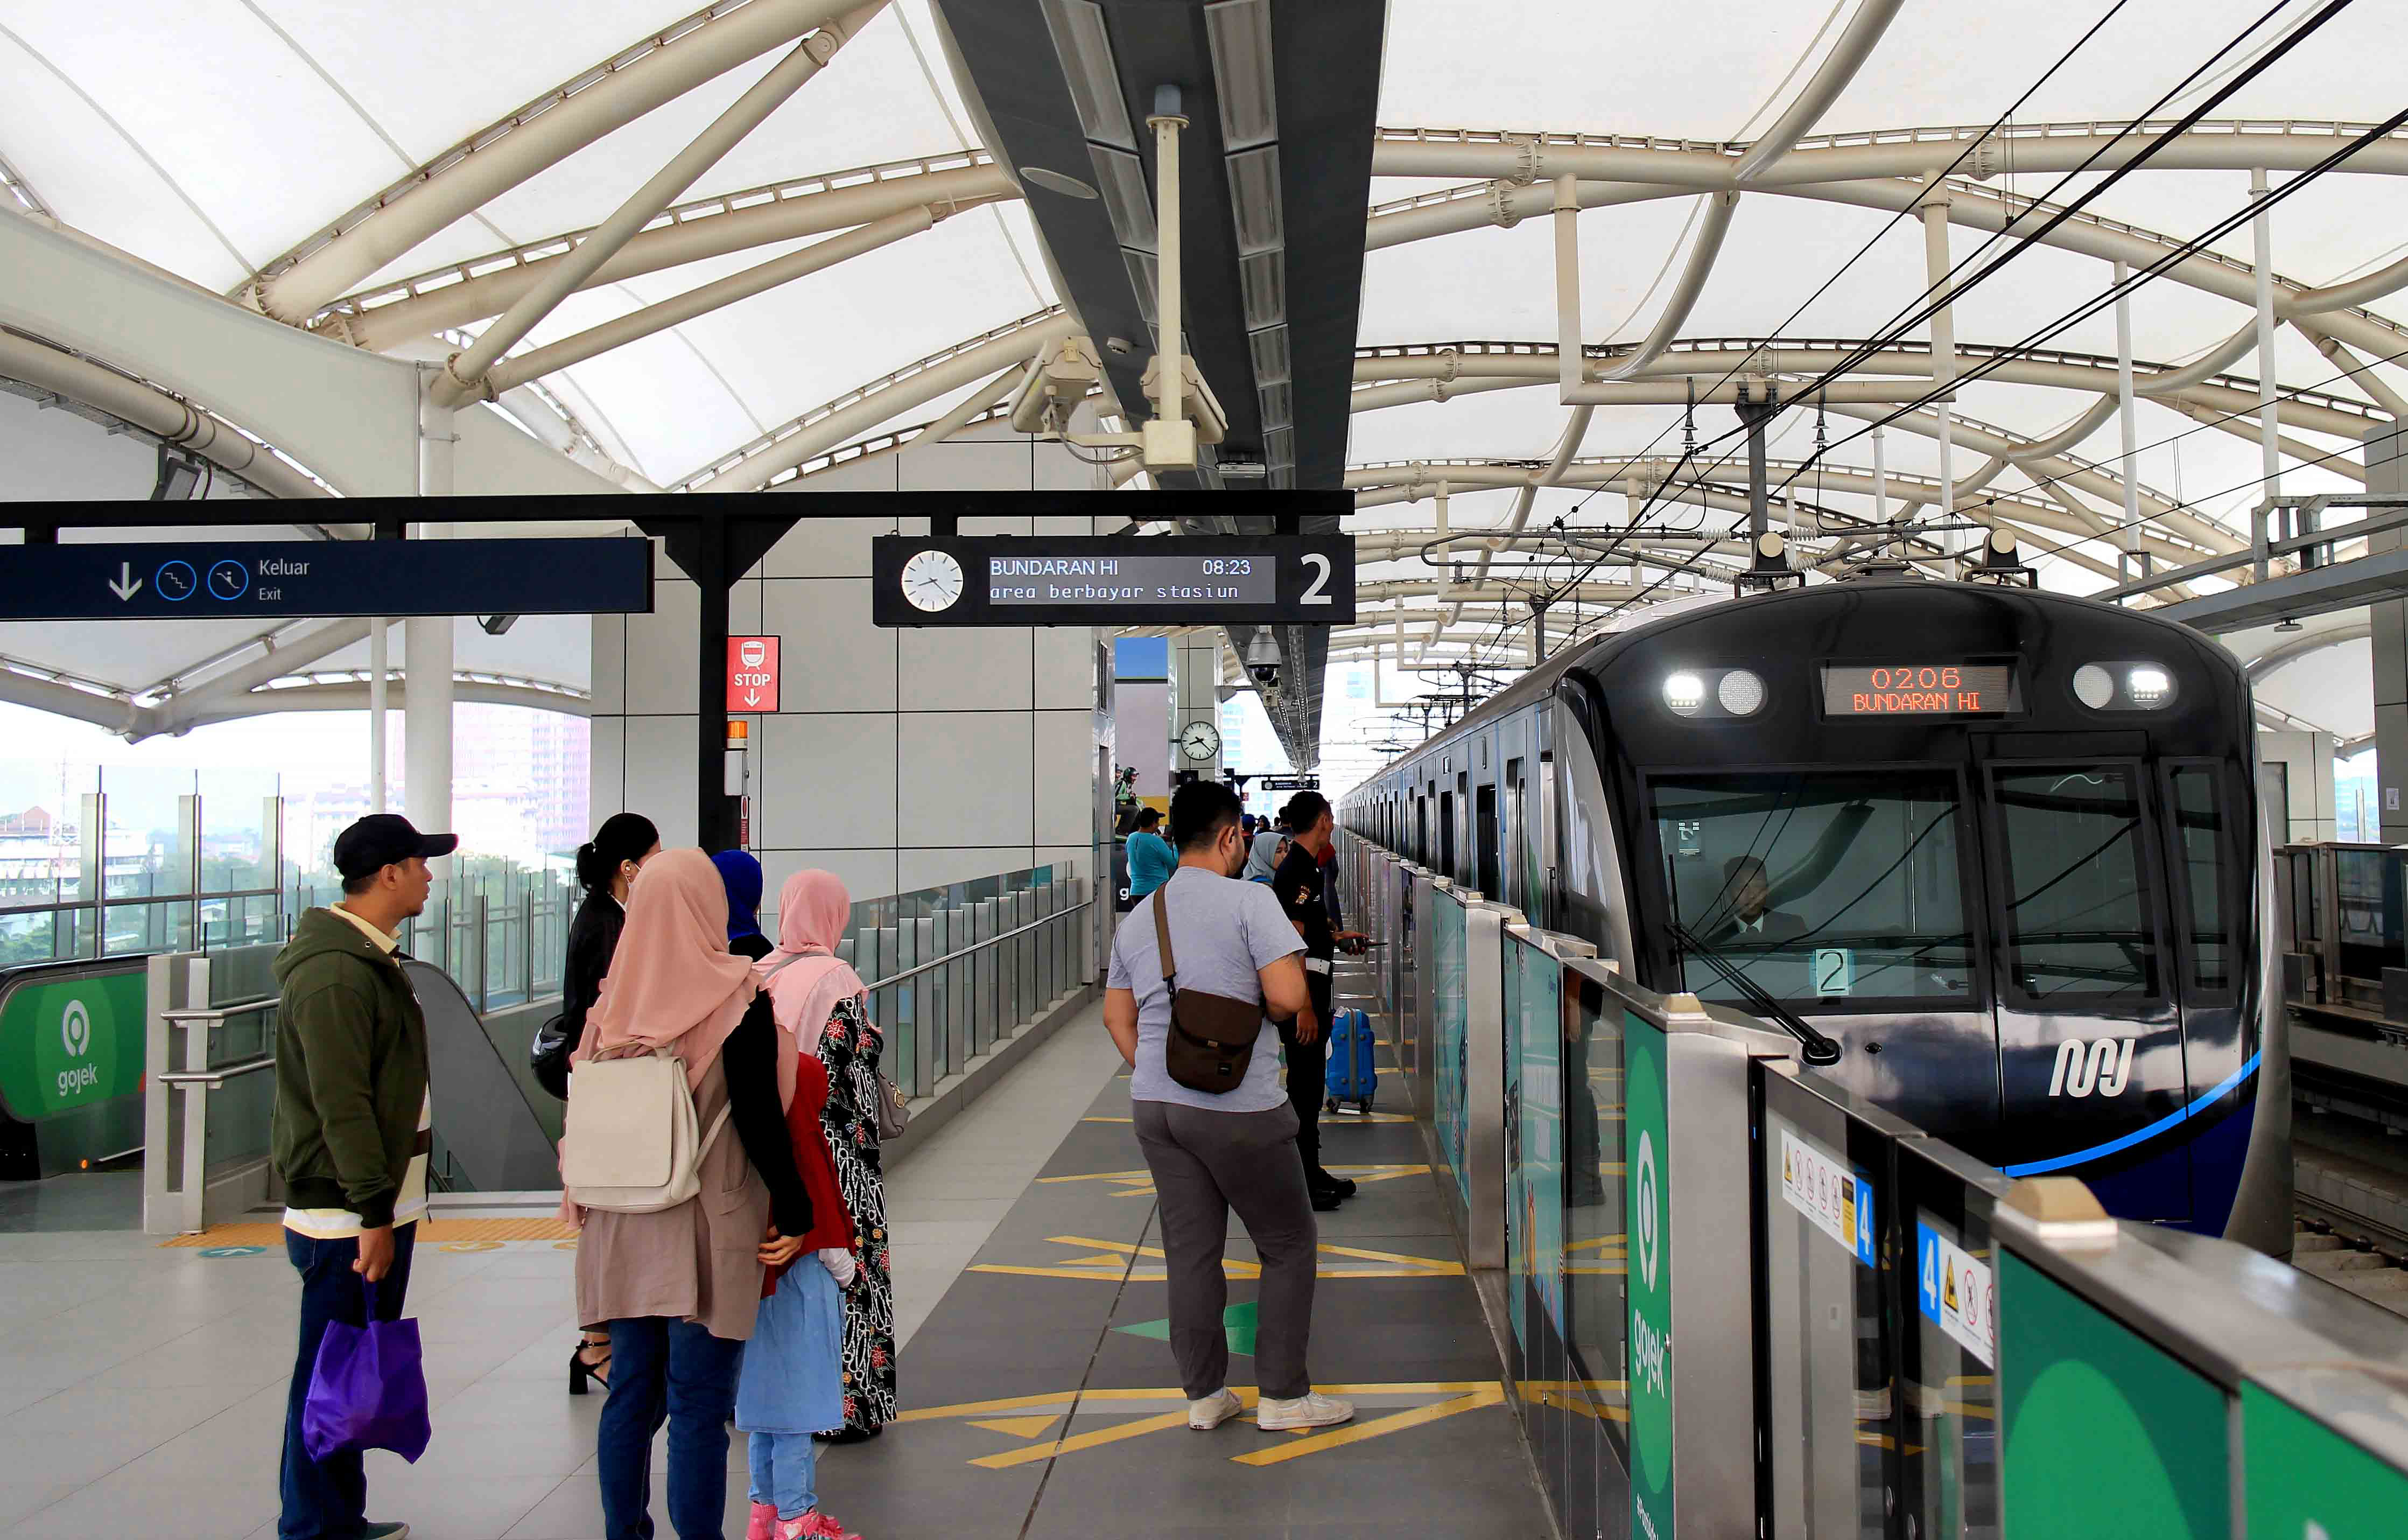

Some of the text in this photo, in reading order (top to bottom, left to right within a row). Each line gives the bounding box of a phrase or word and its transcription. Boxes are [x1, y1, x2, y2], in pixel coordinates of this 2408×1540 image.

[259, 558, 310, 576] Keluar
[991, 560, 1118, 575] BUNDARAN HI
[1202, 559, 1252, 575] 08:23
[1300, 553, 1332, 605] 2
[259, 587, 282, 600] Exit
[990, 583, 1238, 601] area berbayar stasiun
[734, 673, 771, 687] STOP
[1871, 667, 1961, 689] 0206
[1853, 692, 1982, 711] BUNDARAN HI
[1820, 951, 1845, 992] 2
[58, 1063, 99, 1096] gojek
[1860, 1191, 1871, 1255] 4
[1923, 1238, 1937, 1310] 4
[1634, 1309, 1666, 1399] gojek
